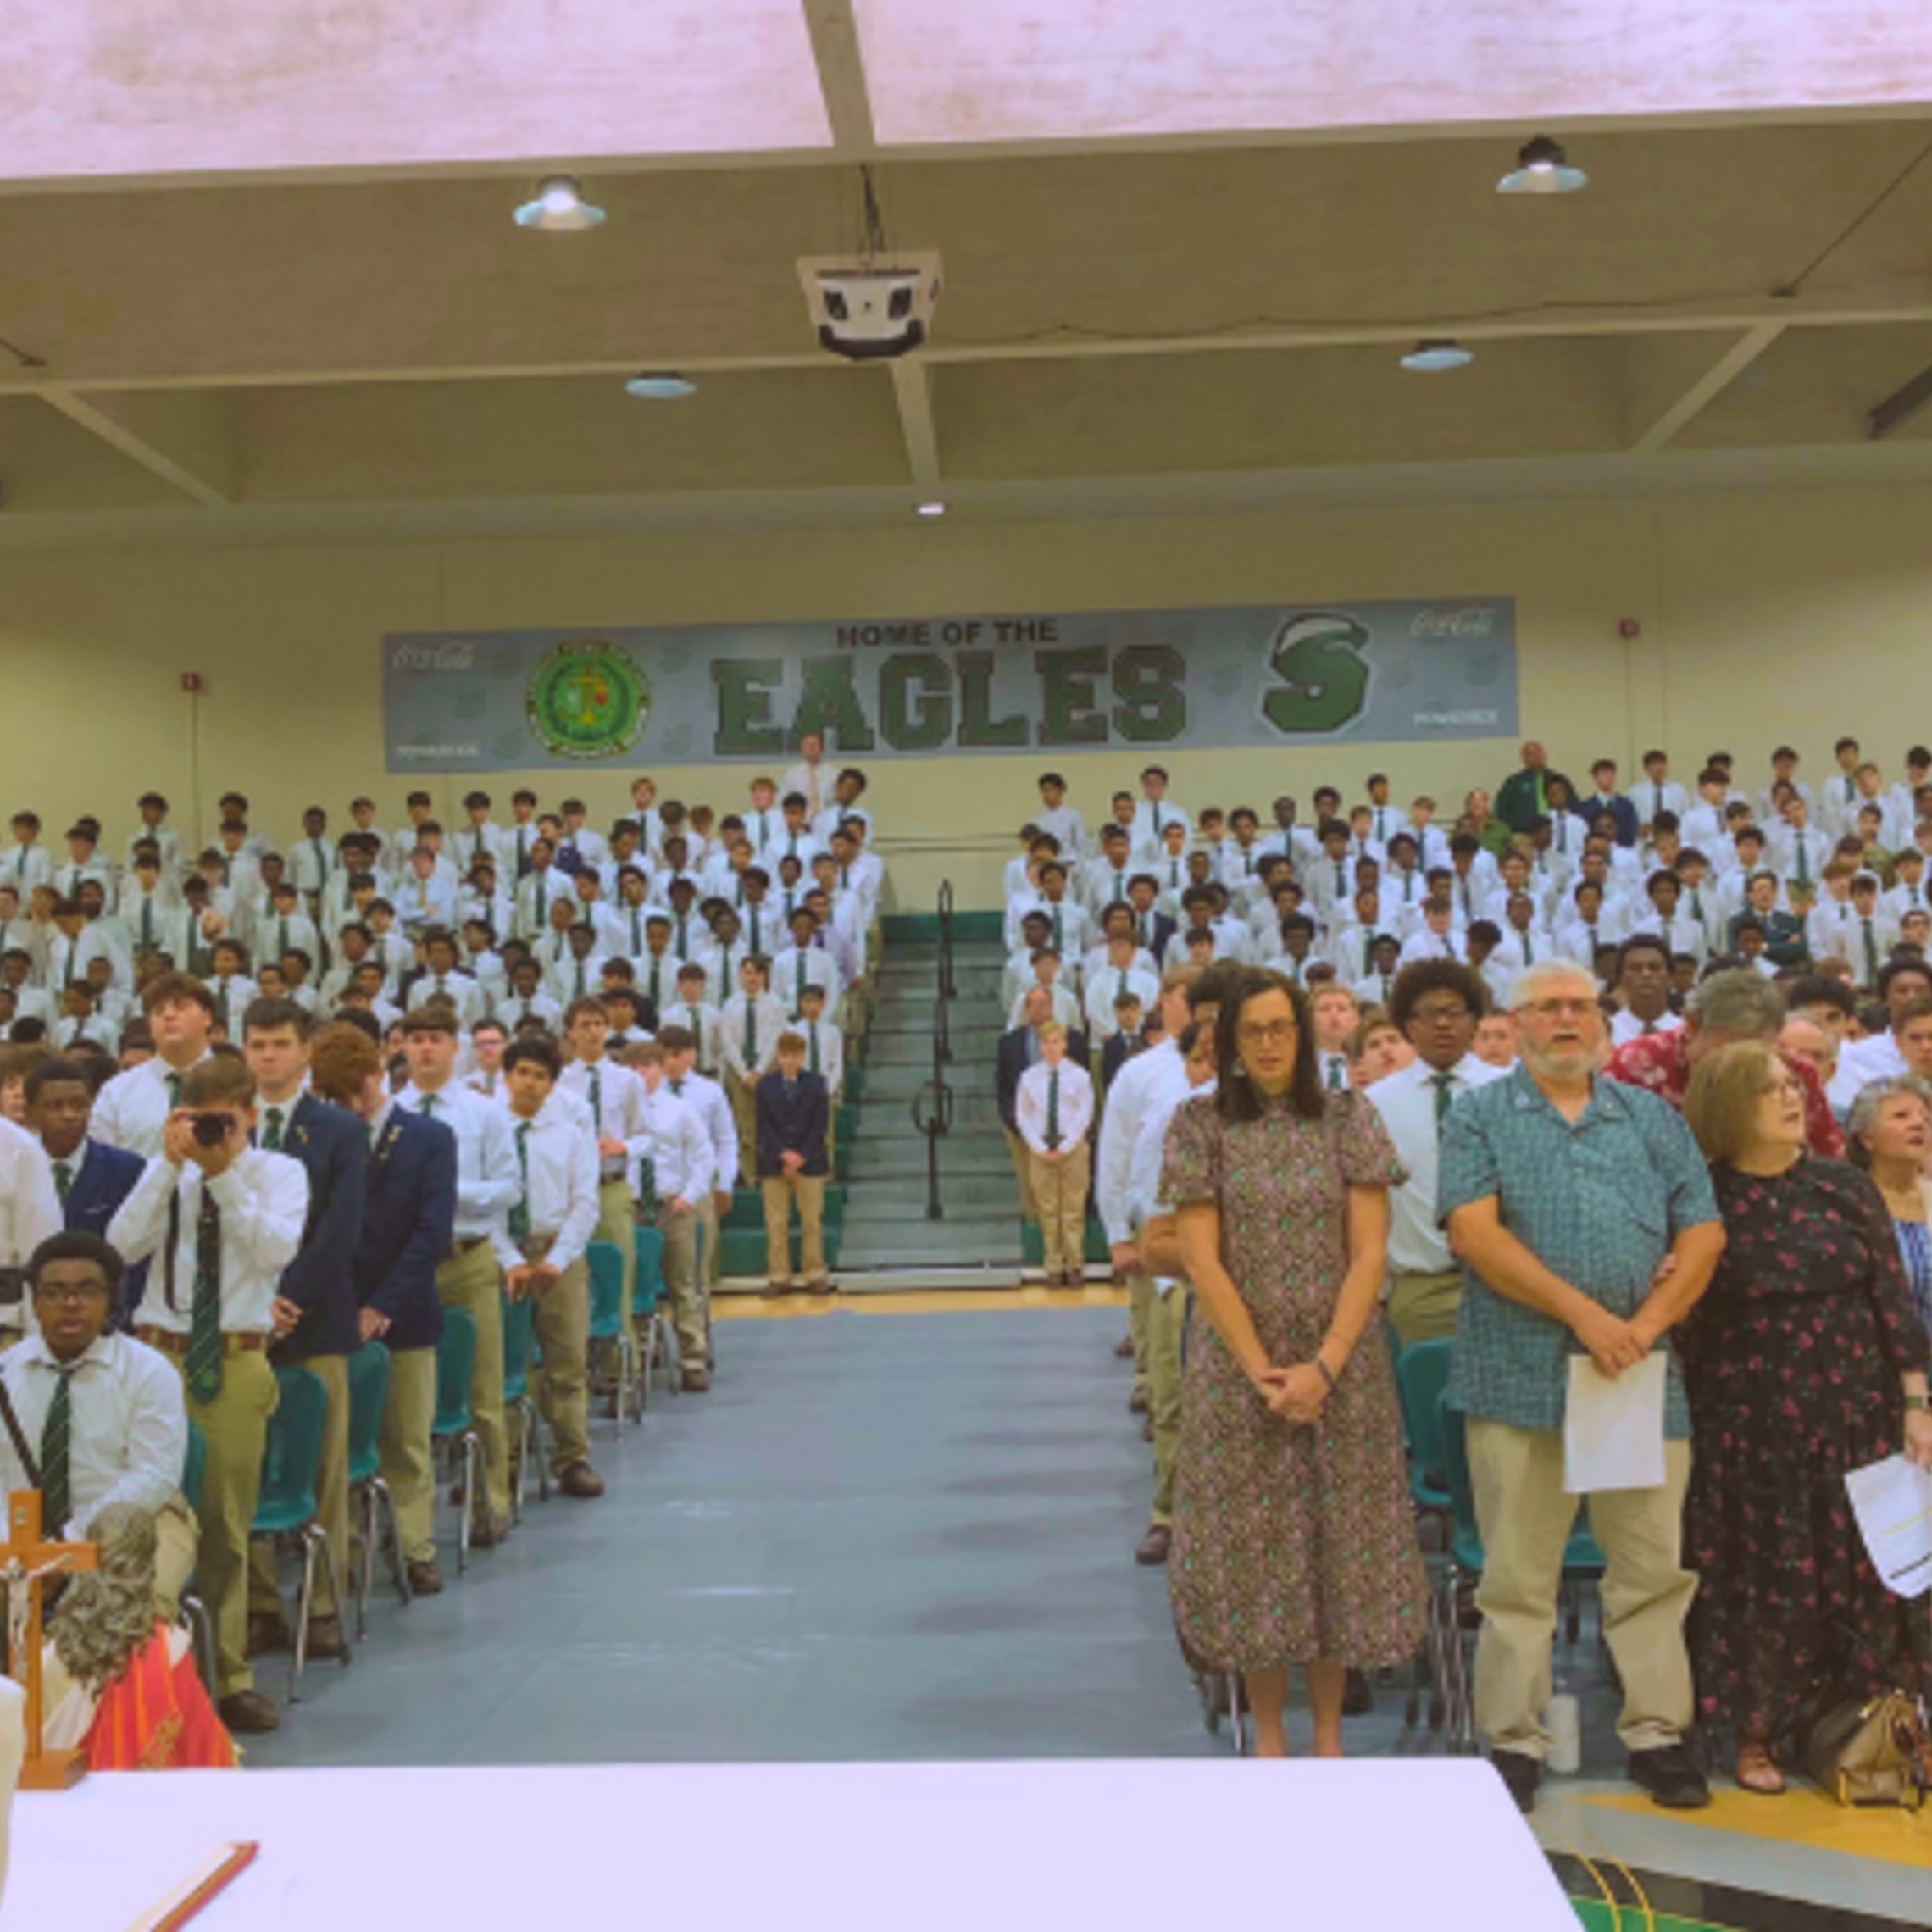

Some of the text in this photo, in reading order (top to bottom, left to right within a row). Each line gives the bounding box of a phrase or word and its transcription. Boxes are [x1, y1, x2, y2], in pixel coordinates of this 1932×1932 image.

[836, 619, 1059, 647] HOME OF THE
[710, 644, 1187, 755] EAGLES
